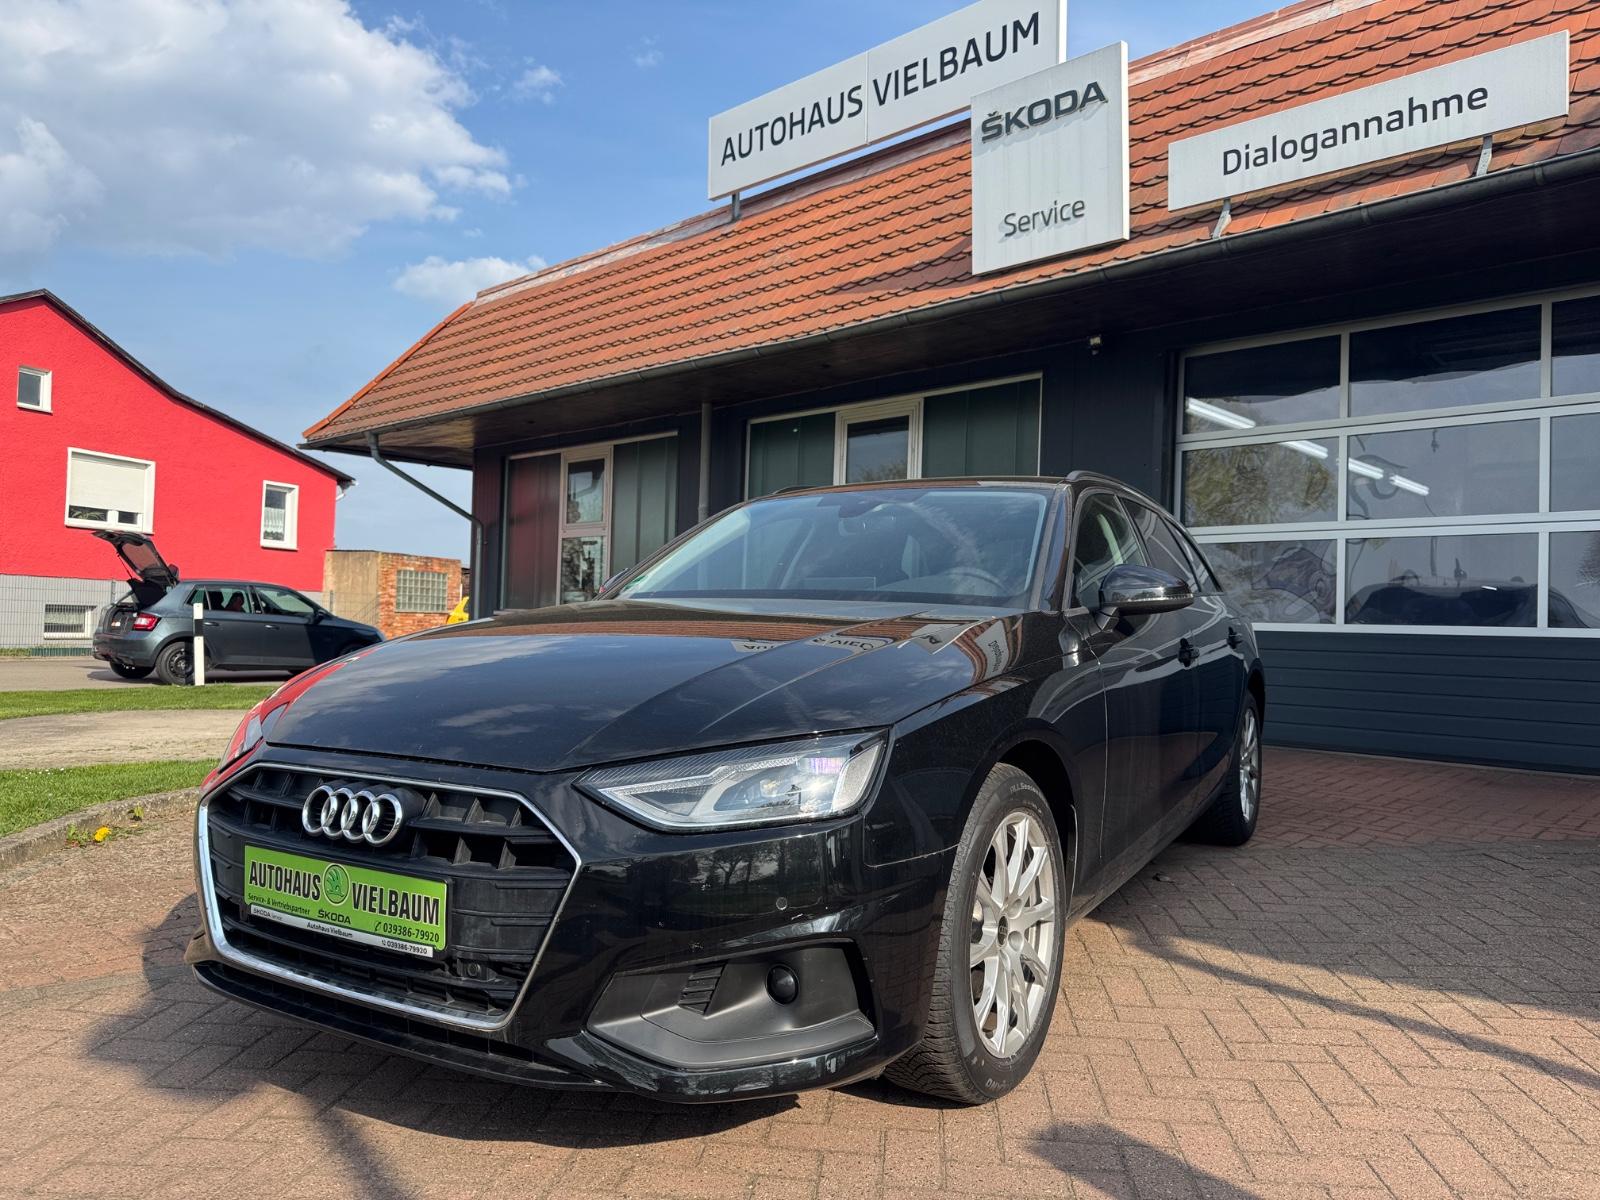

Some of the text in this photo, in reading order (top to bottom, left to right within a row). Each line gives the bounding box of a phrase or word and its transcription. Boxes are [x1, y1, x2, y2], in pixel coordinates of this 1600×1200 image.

[721, 11, 1040, 167] AUTOHAUS VIELBAUM
[981, 81, 1108, 143] ŠKODA
[1222, 86, 1489, 176] Dialogannahme
[1003, 199, 1086, 238] Service
[249, 861, 440, 926] AUTOHAUS VIELBAUM
[271, 900, 310, 916] Vertriebspartner
[306, 922, 353, 938] Autohaus Vielbaum
[318, 908, 352, 924] ŠKODA
[383, 922, 440, 943] 039386-79920
[387, 940, 428, 954] 039386-79920
